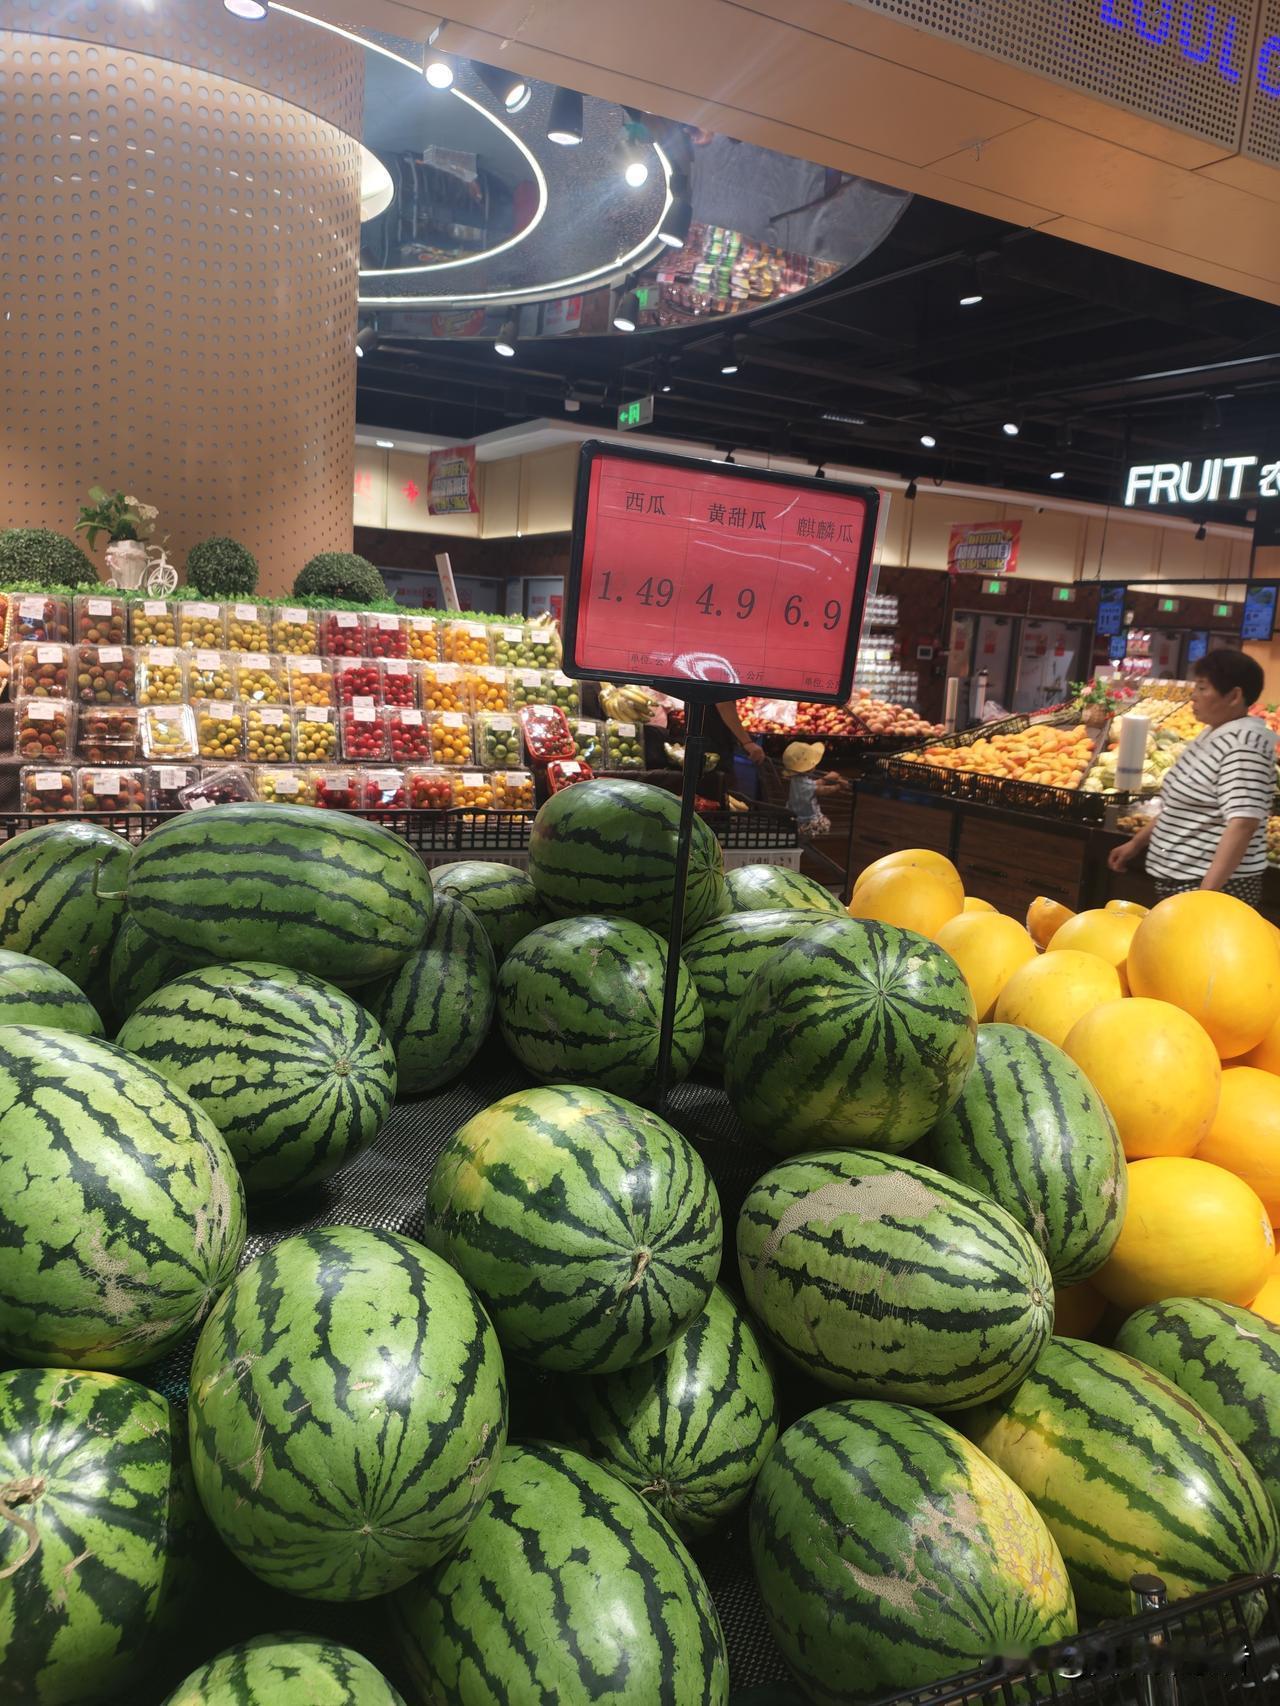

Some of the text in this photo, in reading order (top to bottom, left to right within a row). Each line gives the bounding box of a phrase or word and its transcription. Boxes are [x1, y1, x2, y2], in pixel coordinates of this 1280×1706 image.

[1124, 456, 1258, 506] FRUIT
[625, 491, 854, 543] 西瓜 黄甜瓜 麒麟瓜
[598, 571, 842, 630] 1.49 4.9 6.9
